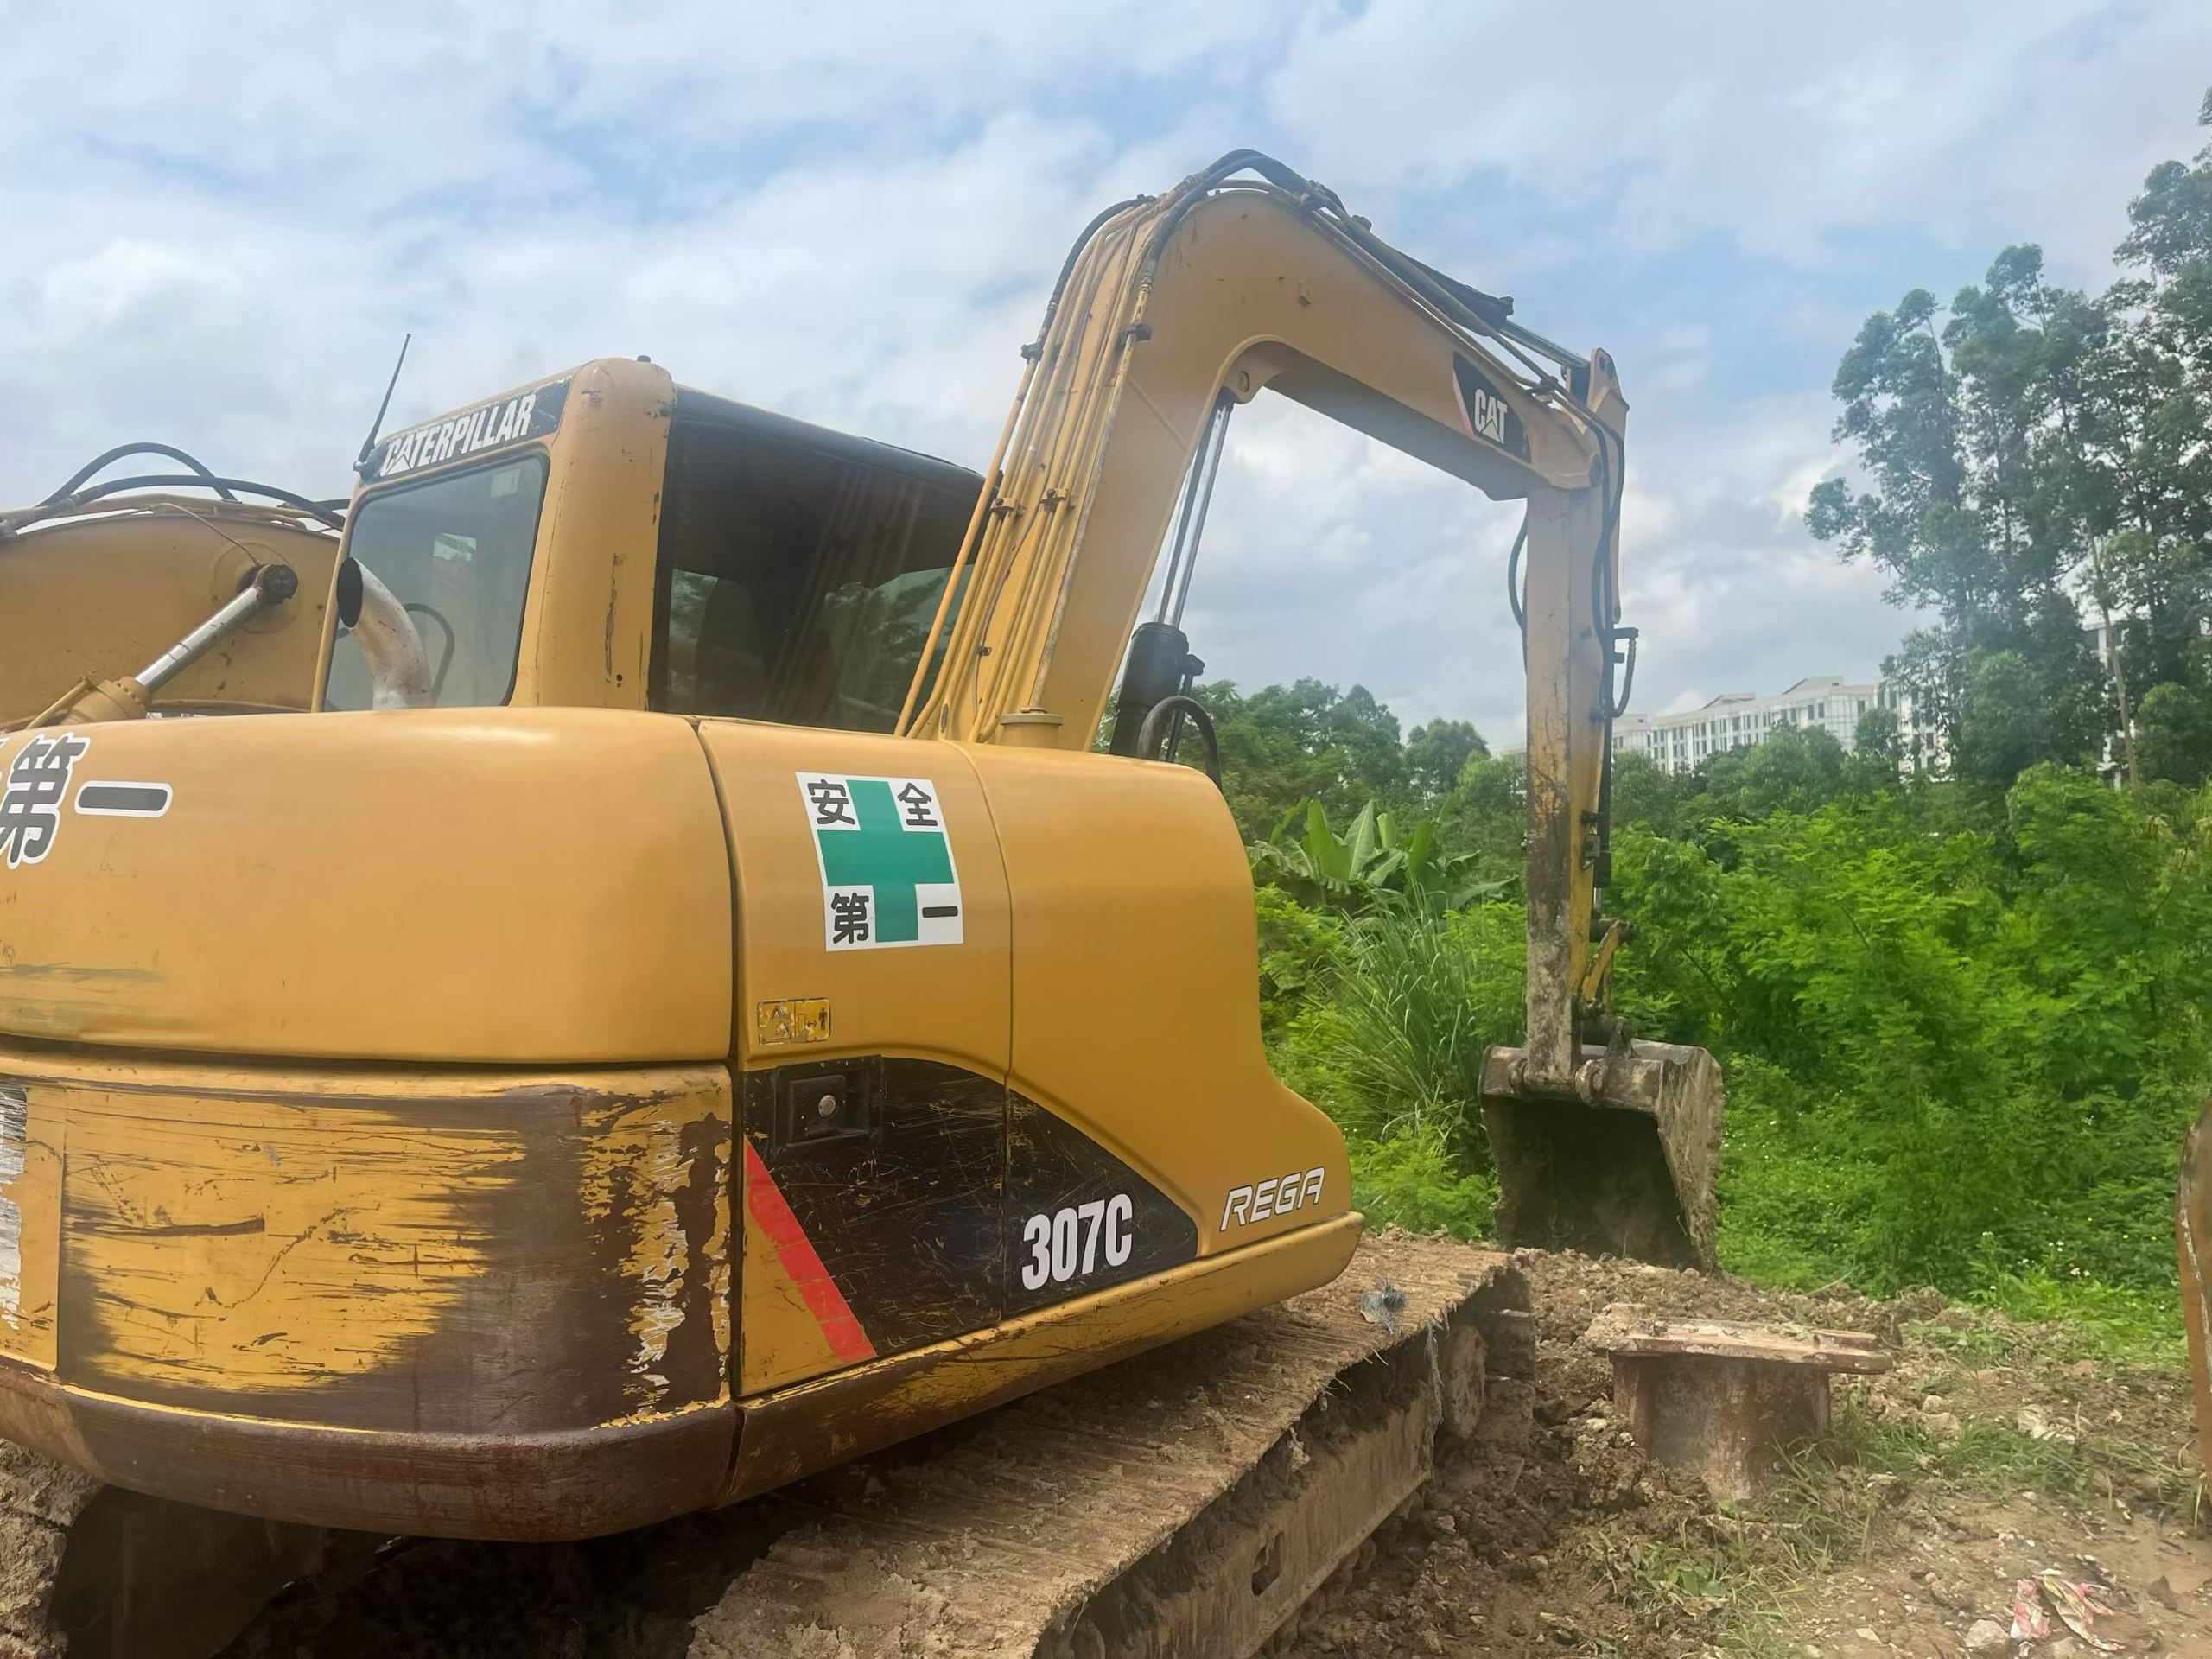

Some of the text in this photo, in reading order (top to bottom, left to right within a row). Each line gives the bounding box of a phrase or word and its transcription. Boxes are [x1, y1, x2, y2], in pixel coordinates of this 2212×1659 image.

[379, 393, 537, 477] CATERPILLAR
[1474, 389, 1508, 444] CAT
[0, 732, 173, 869] 第一
[1219, 1166, 1325, 1231] REGA
[1021, 1193, 1133, 1291] 307C
